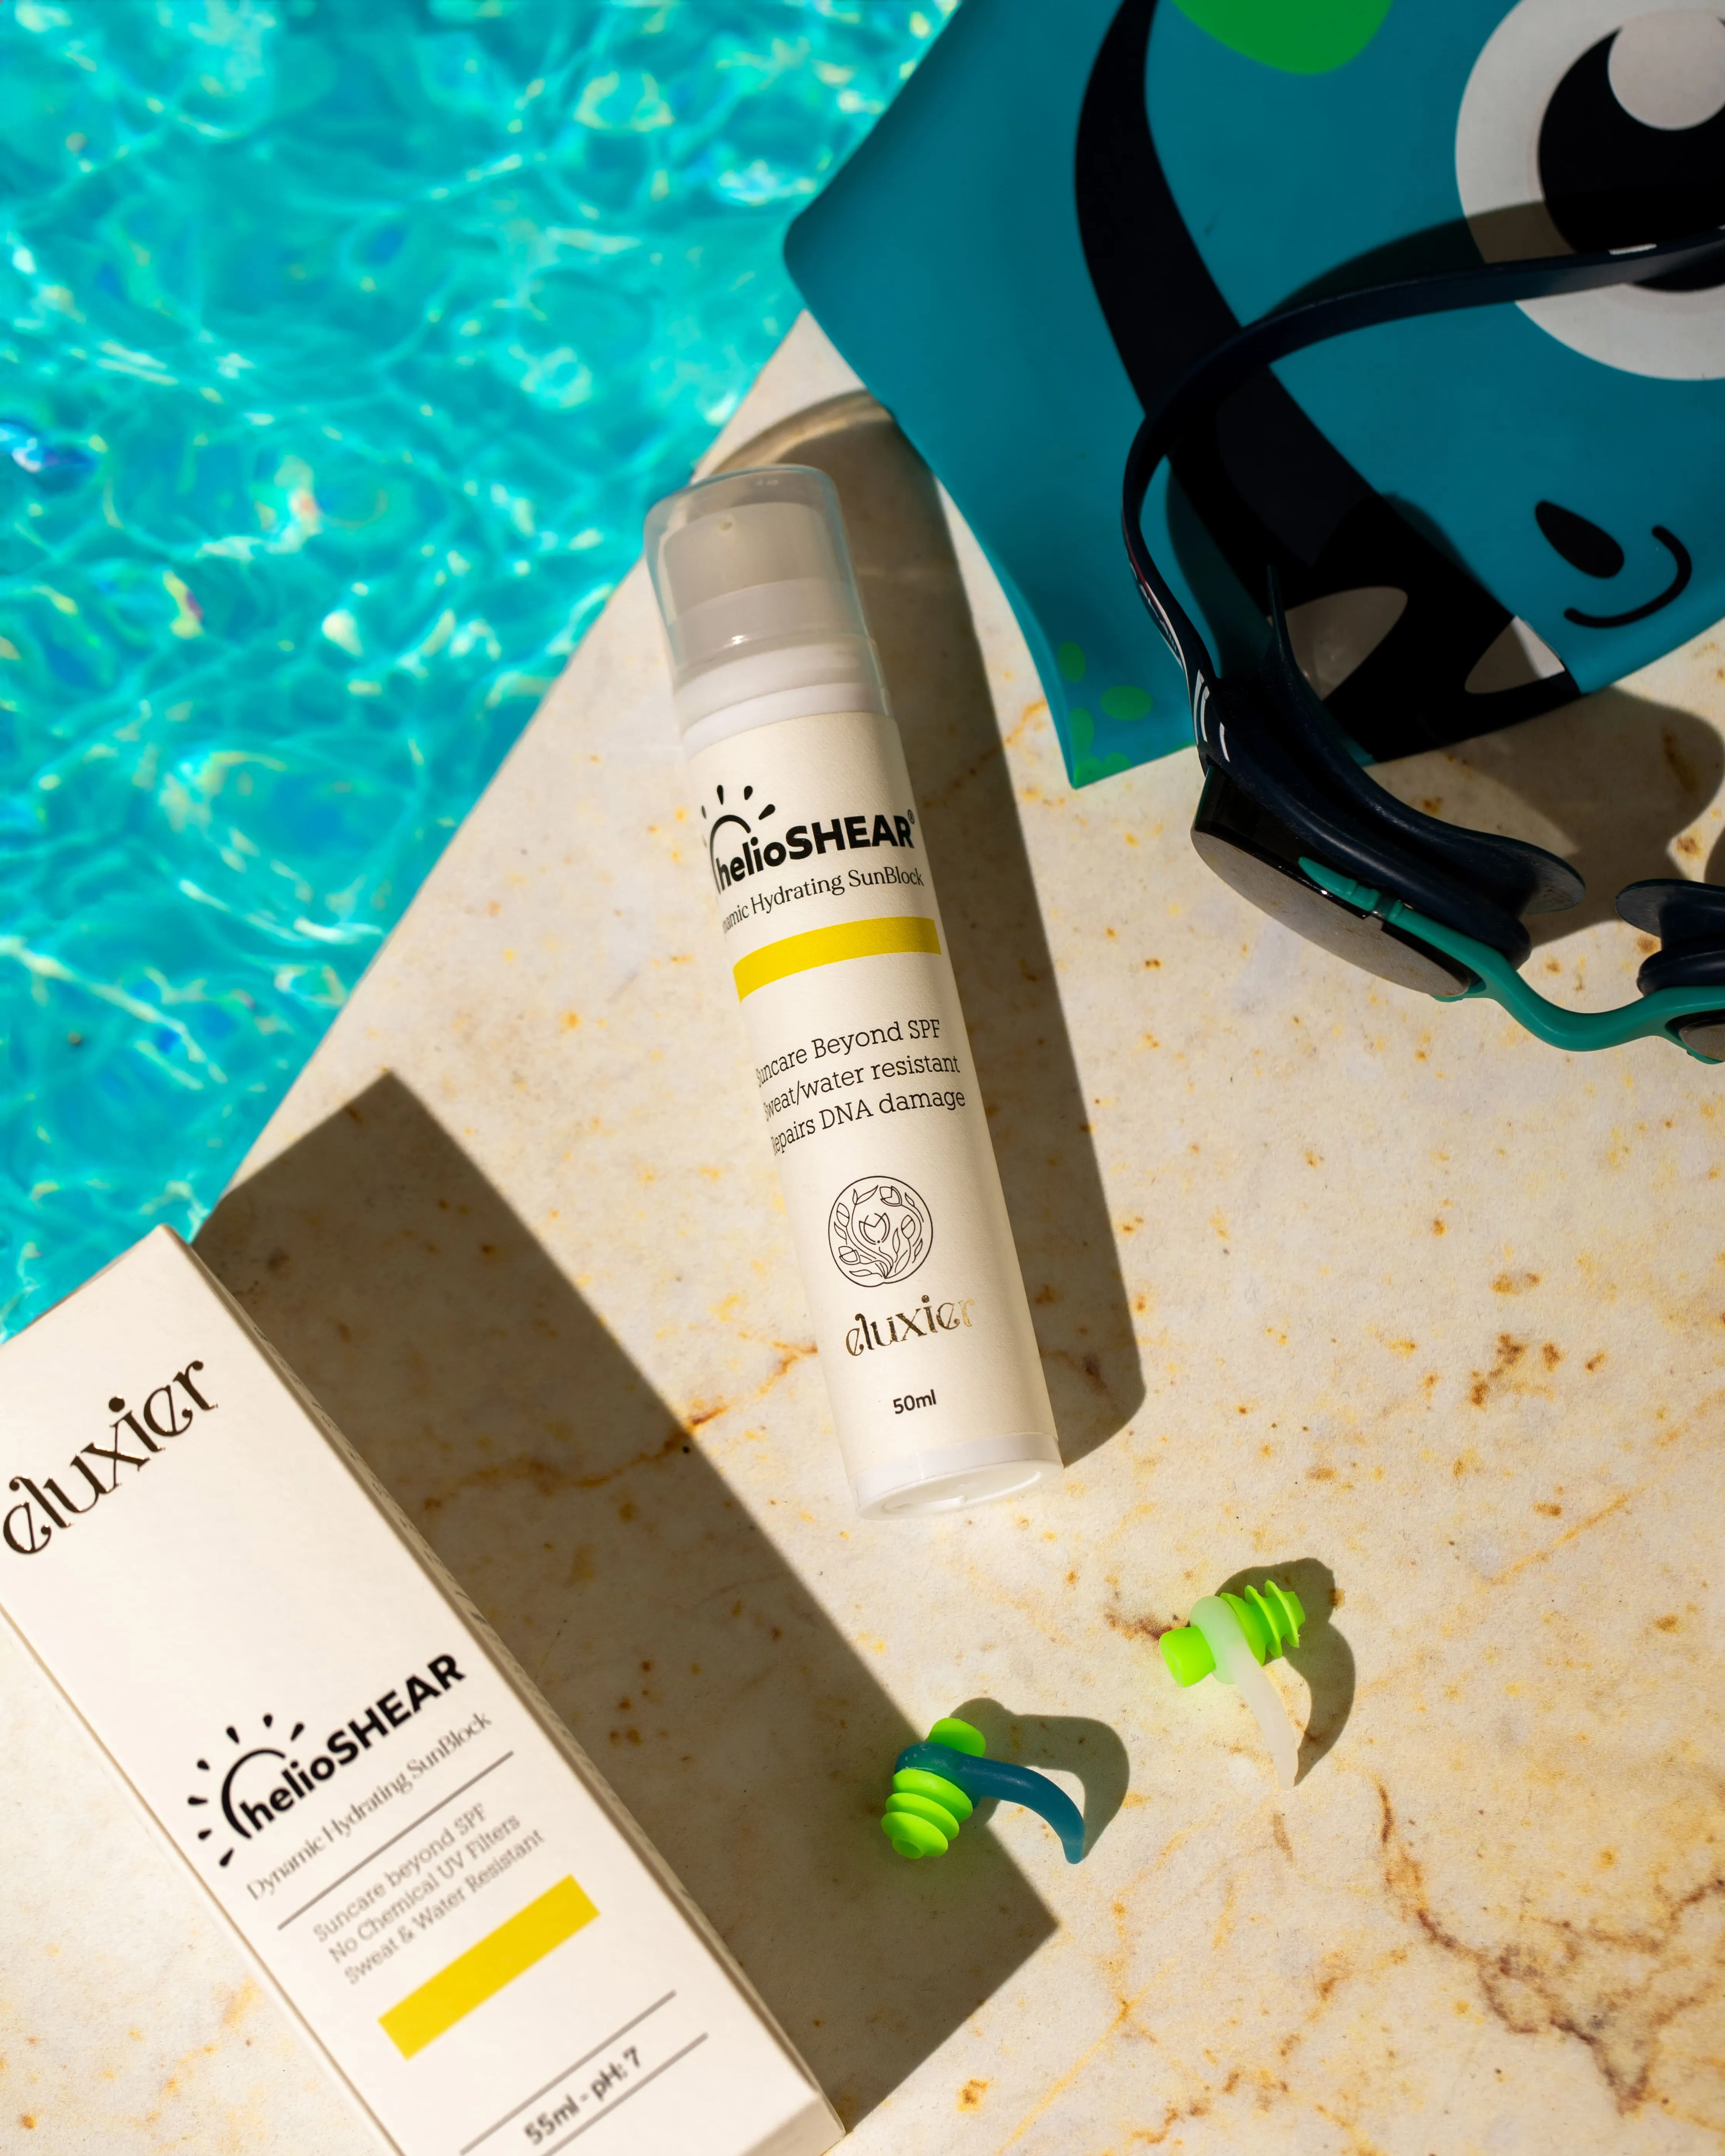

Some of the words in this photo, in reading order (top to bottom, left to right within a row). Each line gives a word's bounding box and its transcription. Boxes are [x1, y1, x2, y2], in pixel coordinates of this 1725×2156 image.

[723, 905, 749, 935] namic
[751, 875, 845, 914] Hydrating
[848, 867, 924, 887] SunBlock
[756, 1048, 807, 1087] Suncare
[812, 1021, 904, 1059] Beyond
[908, 1019, 940, 1039] SPF
[763, 1067, 864, 1122] Sweat/water
[873, 1055, 960, 1080] resistant
[771, 1118, 816, 1155] Repairs
[819, 1099, 874, 1129] DNA
[879, 1093, 966, 1113] damage
[846, 1295, 975, 1356] eluxier
[893, 1389, 936, 1414] 50ml
[3, 1360, 218, 1554] eluxier
[239, 1654, 466, 1831] helioSHEAR
[246, 1833, 326, 1900] Dynamic
[322, 1773, 414, 1843] Hydrating
[406, 1712, 493, 1779] SunBlock
[313, 1881, 387, 1943] Suncare
[384, 1827, 455, 1885] beyond
[454, 1803, 487, 1837] SPF
[328, 1936, 358, 1964] No
[357, 1873, 439, 1943] Chemical
[435, 1853, 466, 1881] UV
[466, 1814, 521, 1860] Filters
[343, 1942, 399, 1985] Sweat
[400, 1928, 415, 1945] &
[411, 1888, 466, 1932] Water
[466, 1828, 545, 1894] Resistant
[524, 2093, 581, 2146] 55ml
[590, 2062, 628, 2102] pH:
[622, 2045, 641, 2069] 7
